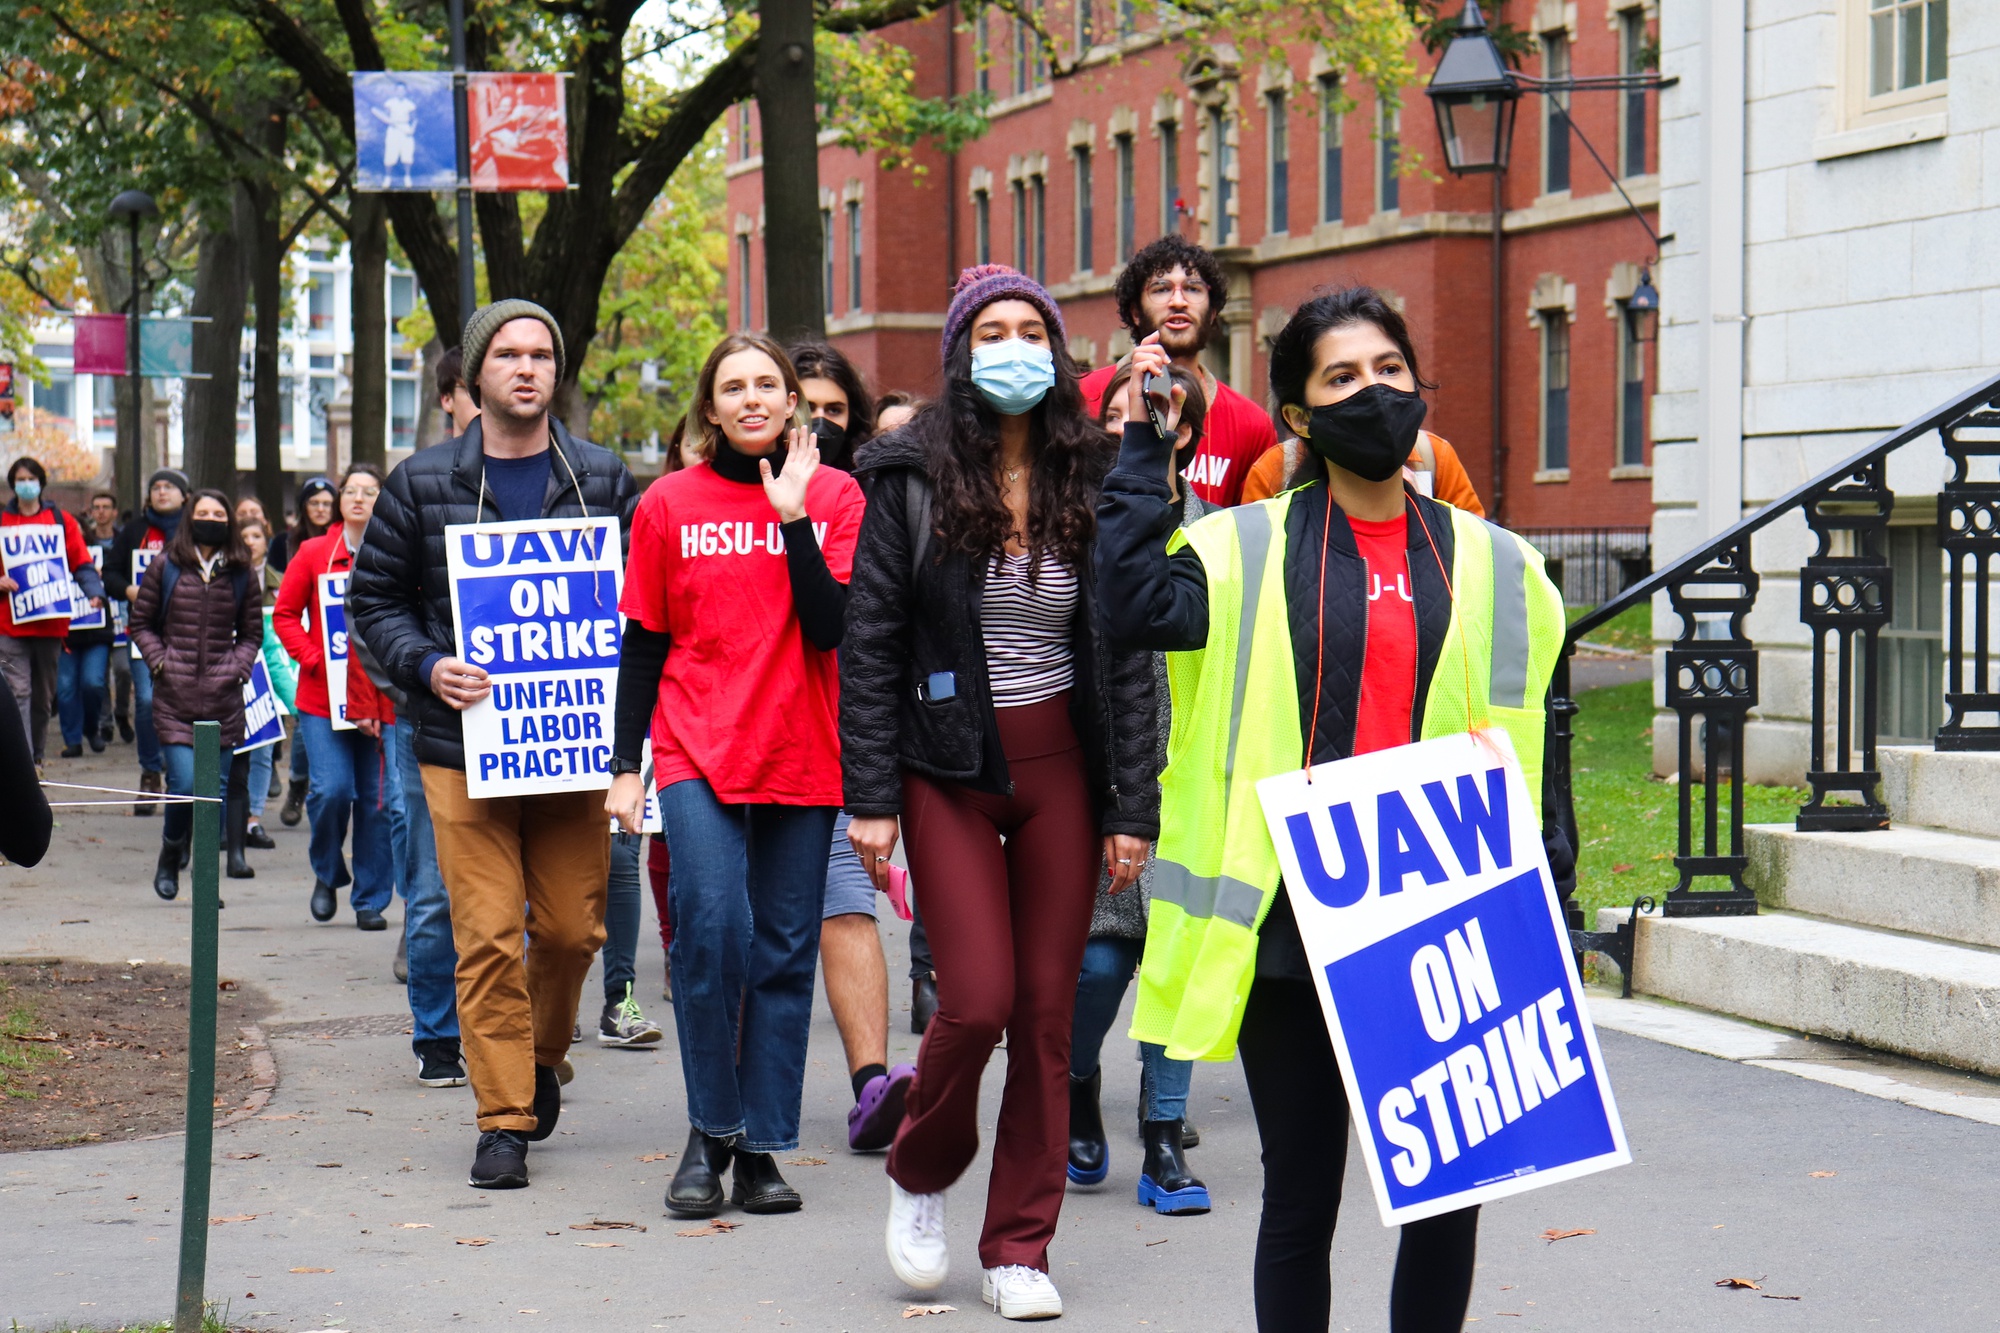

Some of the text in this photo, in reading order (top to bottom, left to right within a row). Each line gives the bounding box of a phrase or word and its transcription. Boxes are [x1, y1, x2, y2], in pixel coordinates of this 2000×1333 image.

[4, 533, 59, 556] UAW
[460, 526, 608, 568] UAW
[680, 521, 828, 559] HGSU-UW
[26, 561, 50, 588] ON
[14, 579, 69, 617] STRIKE
[509, 576, 571, 618] ON
[469, 618, 619, 665] STRIKE
[492, 678, 605, 711] UNFAIR
[501, 712, 603, 745] LABOR
[479, 744, 614, 782] PRACTIC
[1285, 767, 1512, 908] UAW
[1409, 916, 1503, 1044] ON
[1377, 986, 1586, 1187] STRIKE
